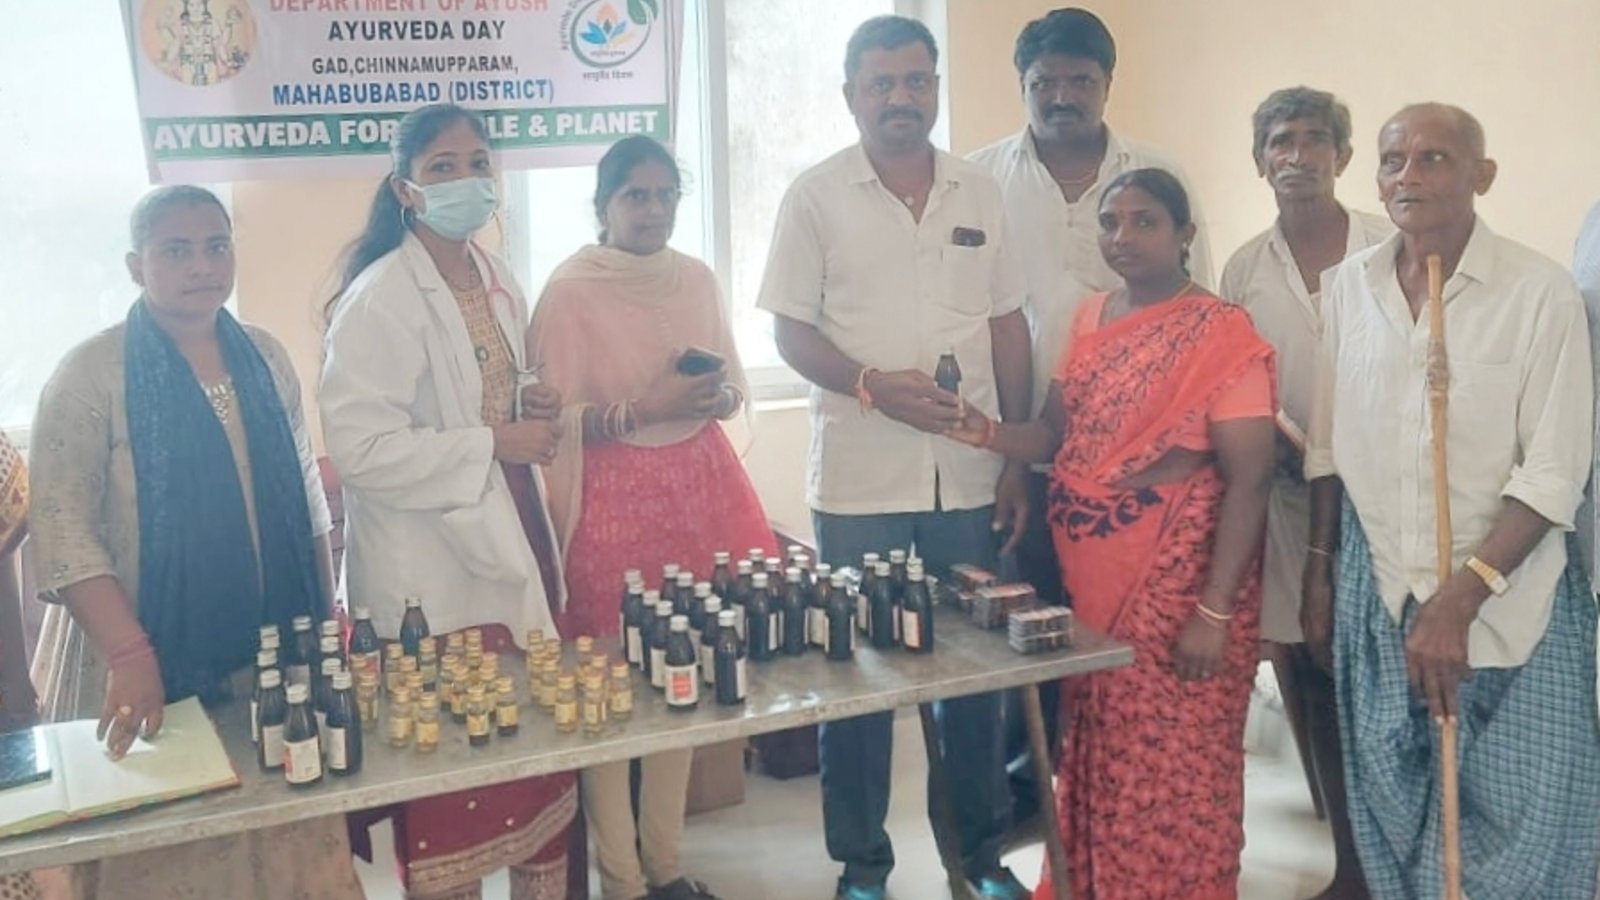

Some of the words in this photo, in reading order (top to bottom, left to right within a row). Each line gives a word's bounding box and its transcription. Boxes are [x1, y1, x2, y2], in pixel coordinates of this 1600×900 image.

[328, 21, 454, 41] AYURVEDA
[461, 20, 505, 40] DAY
[273, 82, 440, 105] MAHABUBABAD
[448, 79, 554, 103] (DISTRICT)
[153, 120, 331, 150] AYURVEDA
[340, 119, 400, 145] FOR
[528, 114, 549, 138] &
[556, 110, 658, 136] PLANET
